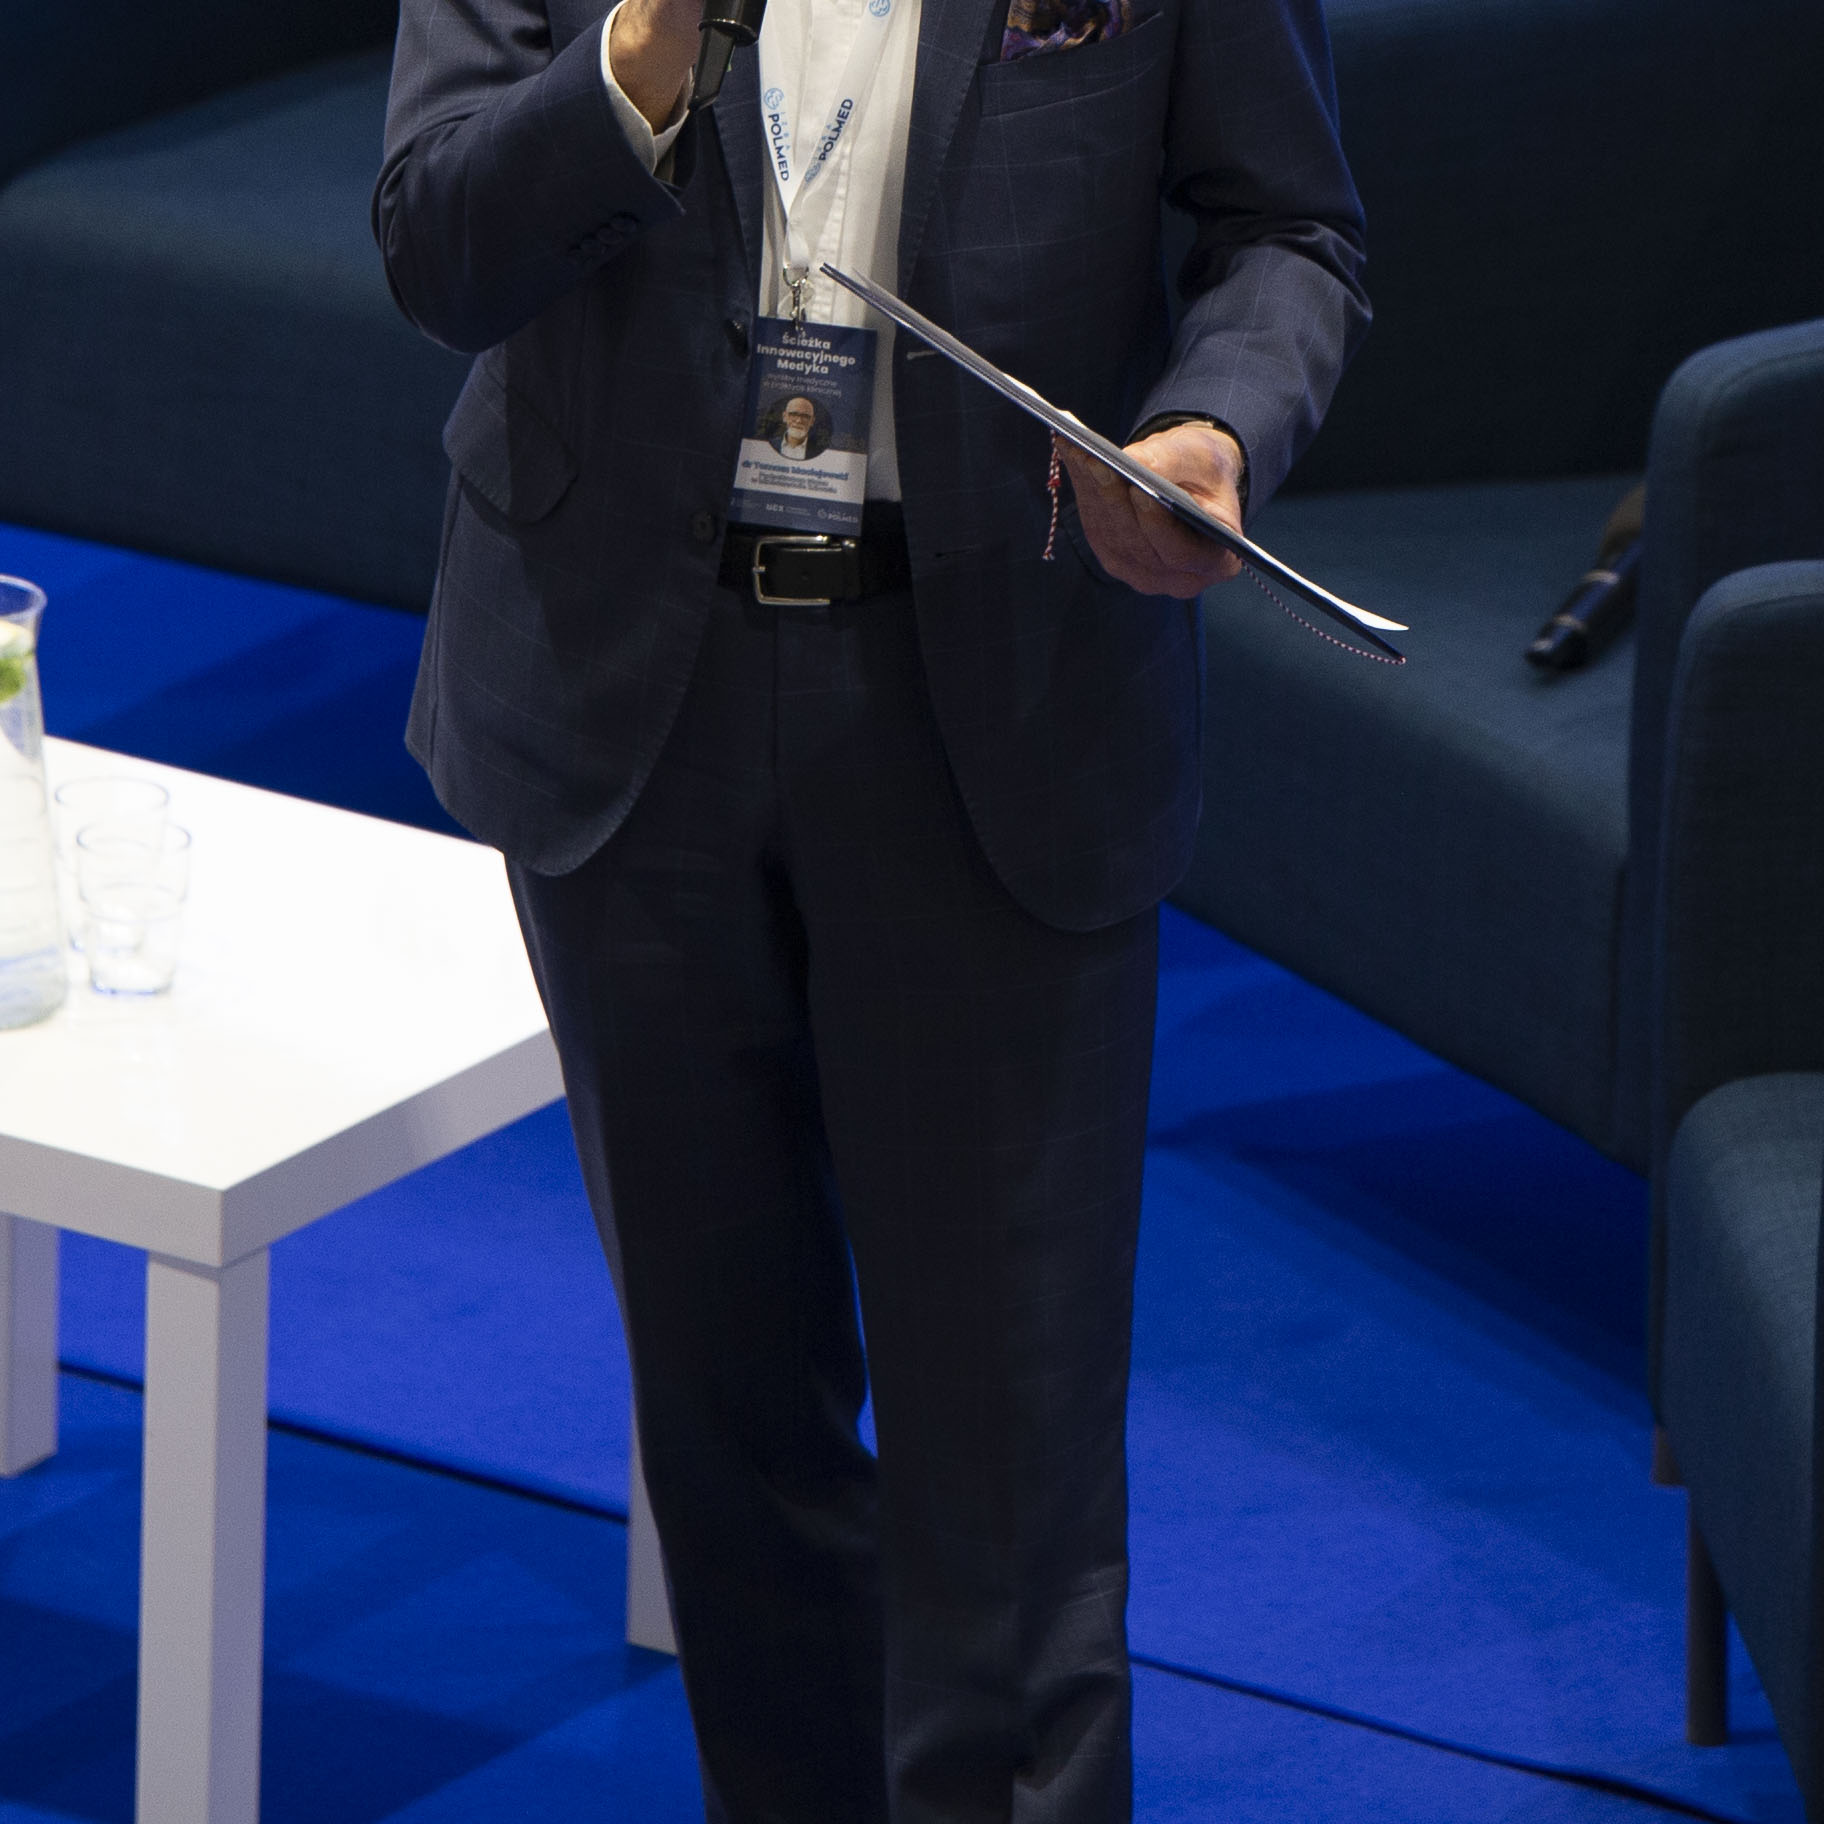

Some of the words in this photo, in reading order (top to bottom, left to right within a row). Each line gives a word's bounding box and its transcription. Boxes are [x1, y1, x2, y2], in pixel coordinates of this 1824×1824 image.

[768, 113, 790, 181] POLMED
[818, 98, 853, 161] POLMED
[756, 344, 856, 367] Innowacyjnego
[777, 359, 829, 375] Medyka
